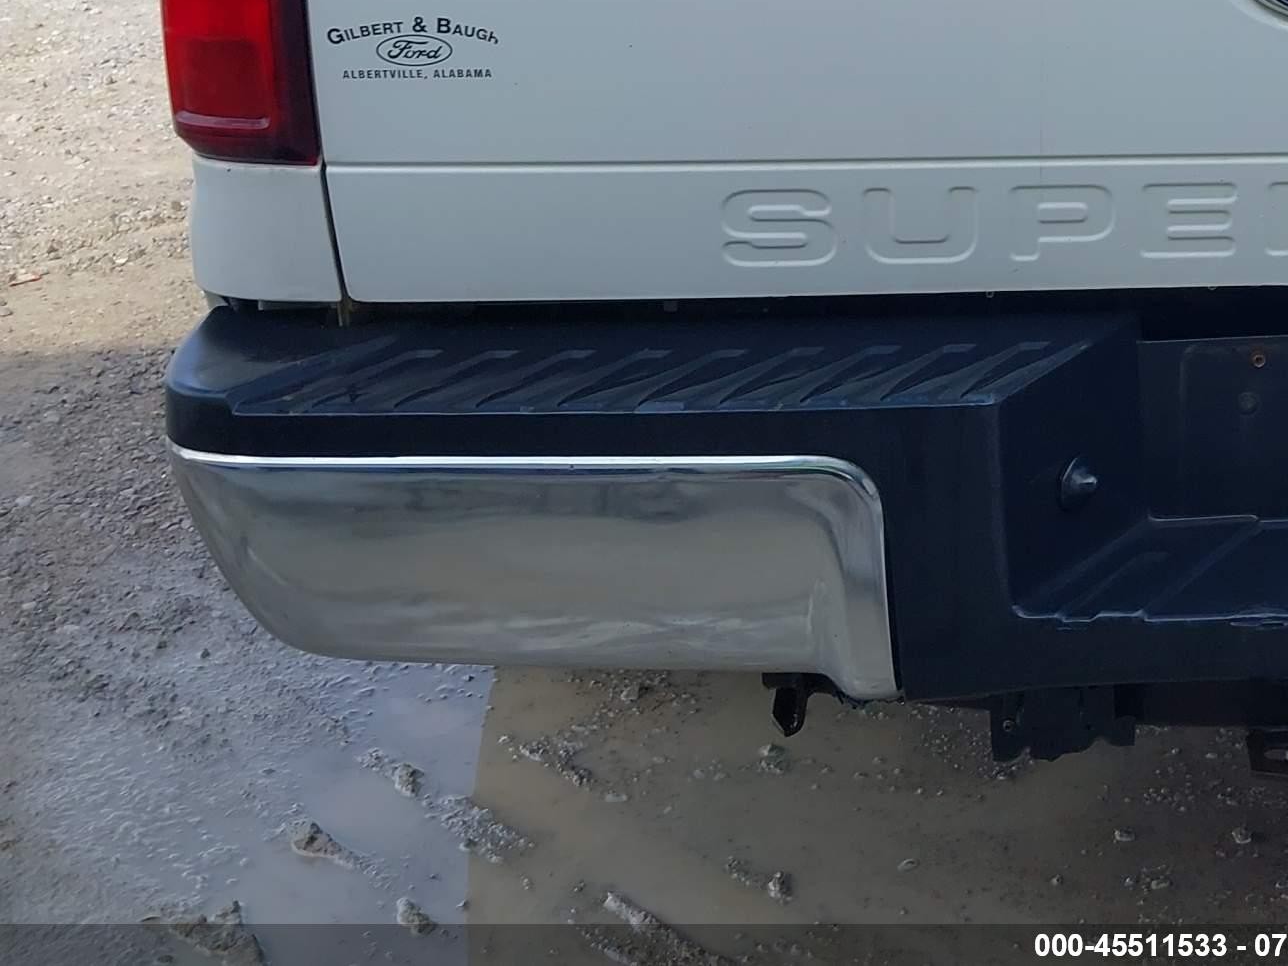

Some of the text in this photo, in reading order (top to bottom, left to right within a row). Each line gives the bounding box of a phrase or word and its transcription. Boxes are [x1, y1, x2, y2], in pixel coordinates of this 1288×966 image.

[327, 21, 403, 45] GILBERT
[412, 16, 428, 33] &
[387, 39, 443, 60] Ford
[342, 69, 493, 80] ALBERTVILLE, ALABAMA
